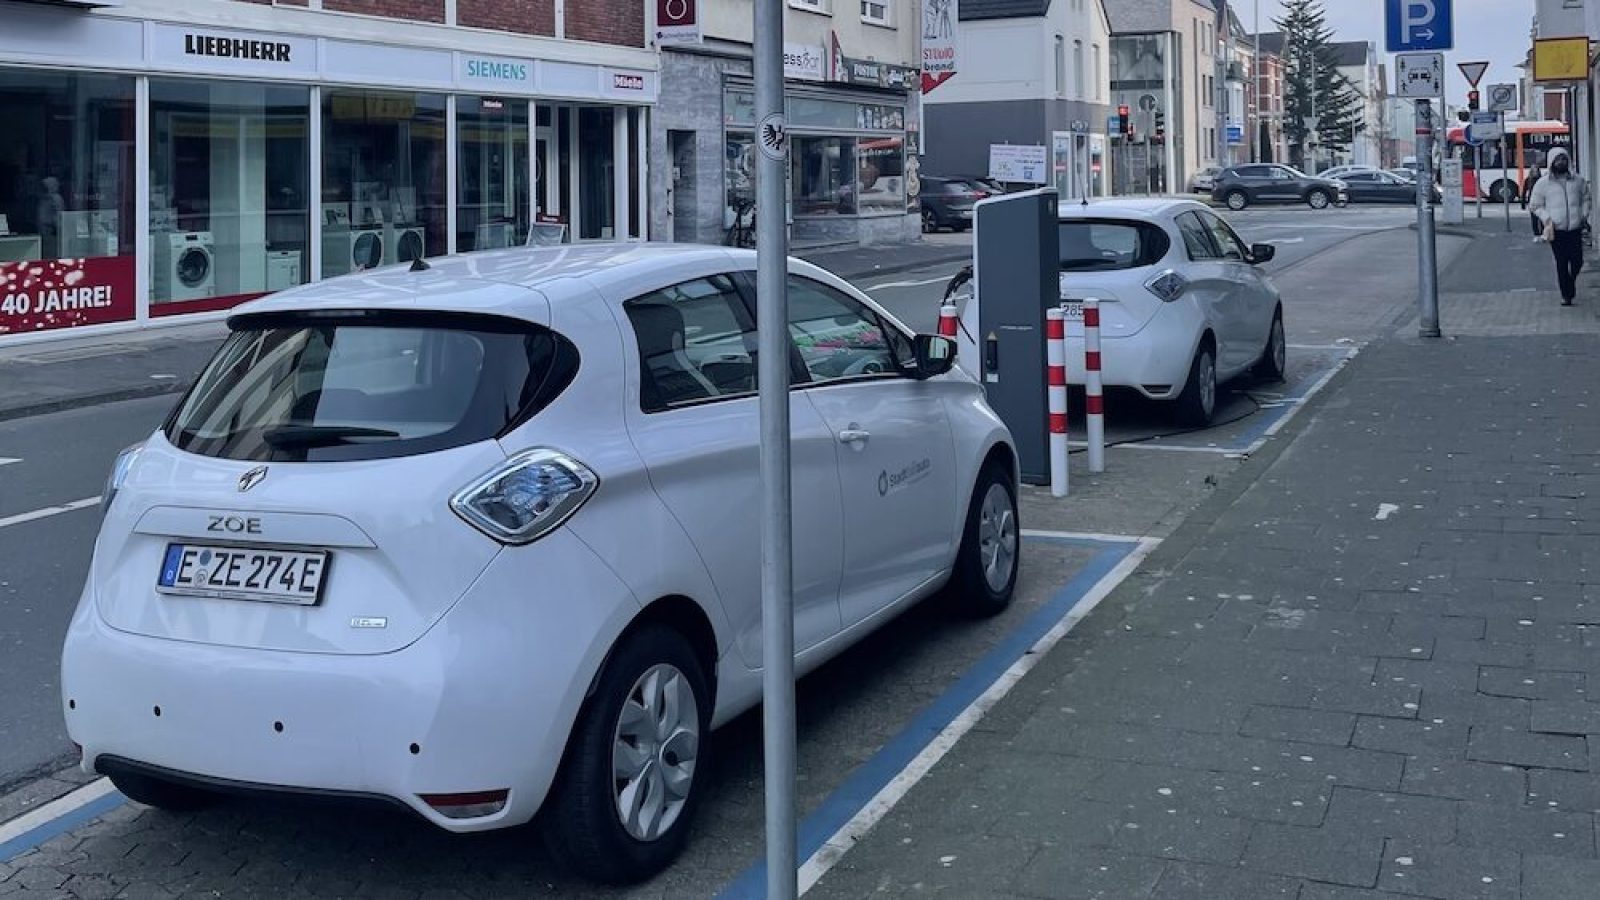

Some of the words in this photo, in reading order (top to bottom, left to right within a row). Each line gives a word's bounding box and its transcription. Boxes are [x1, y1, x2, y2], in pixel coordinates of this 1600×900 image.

[1401, 0, 1436, 44] P
[185, 34, 291, 62] LIEBHERR
[923, 47, 955, 60] STUDIO
[468, 60, 526, 80] SIEMENS
[924, 61, 954, 71] brand
[615, 75, 642, 89] Miele
[1, 293, 30, 316] 40
[34, 285, 112, 313] JAHRE!
[207, 515, 263, 535] ZOE
